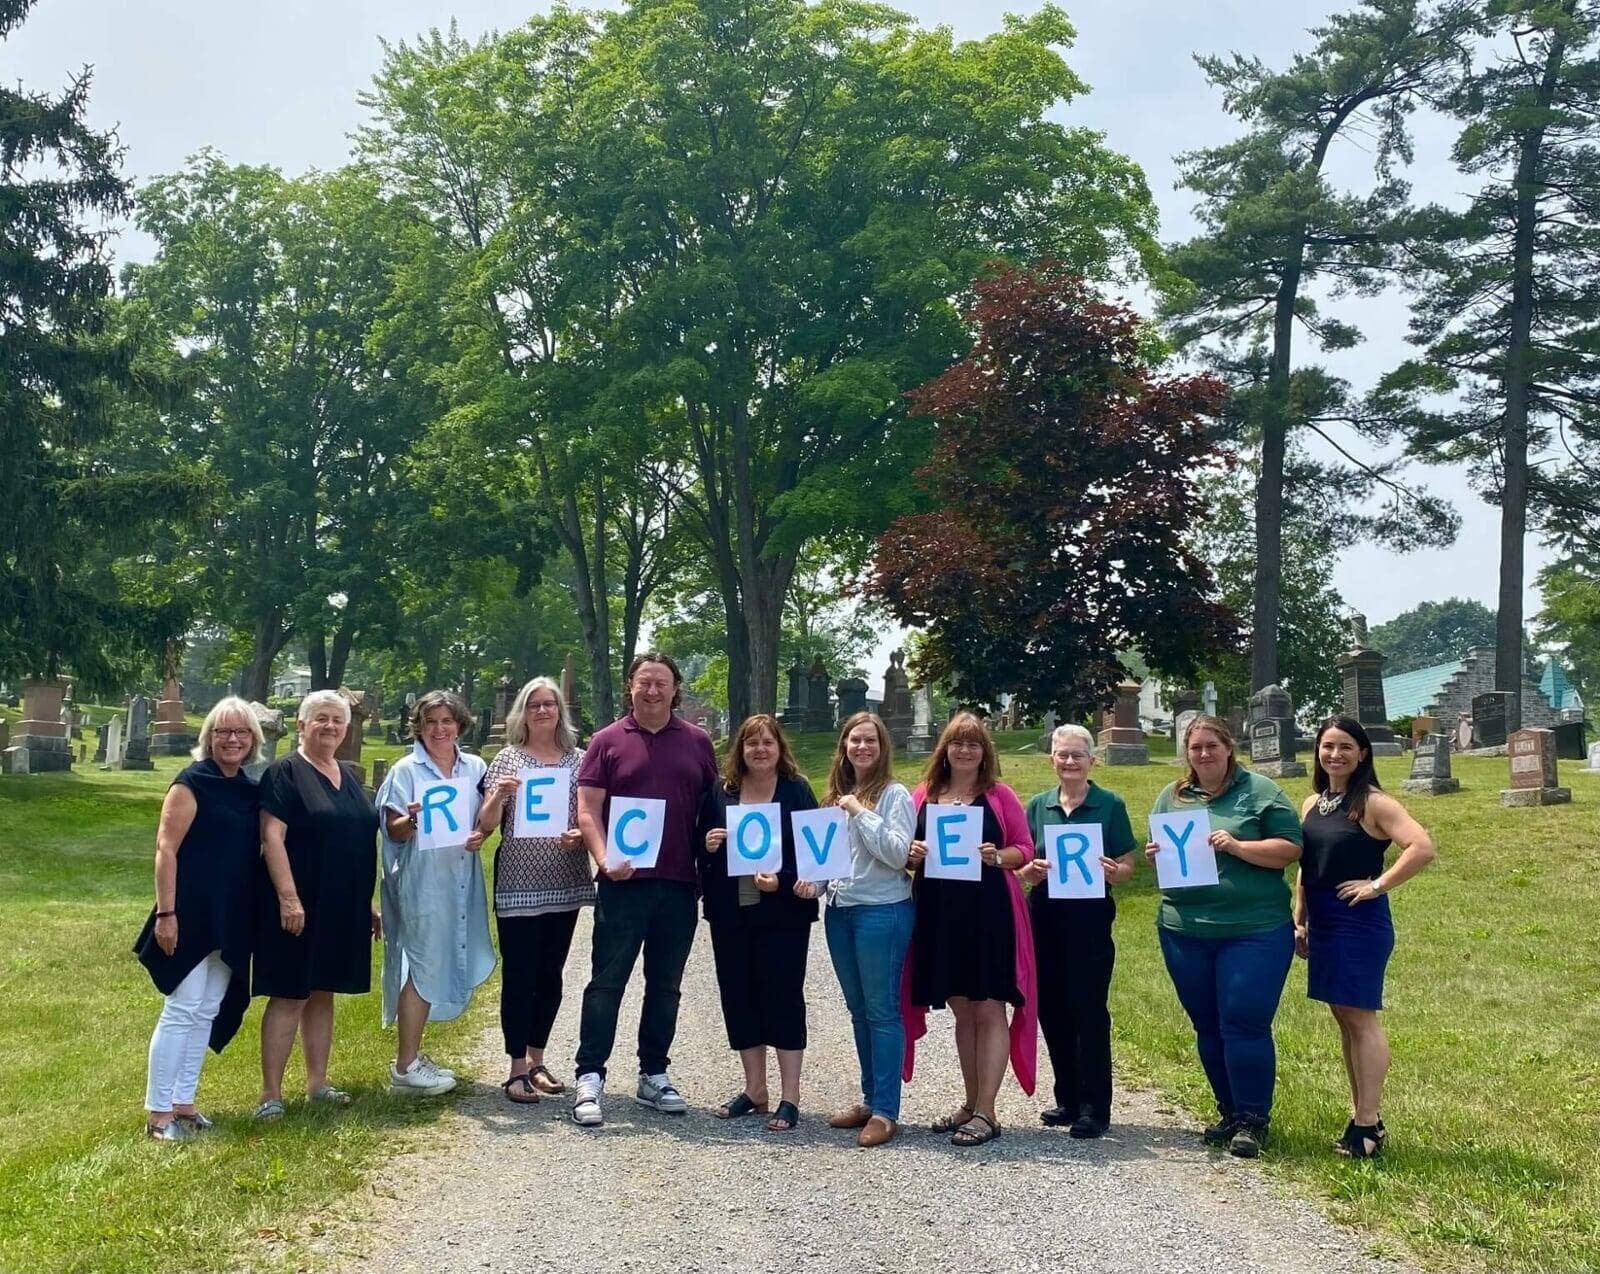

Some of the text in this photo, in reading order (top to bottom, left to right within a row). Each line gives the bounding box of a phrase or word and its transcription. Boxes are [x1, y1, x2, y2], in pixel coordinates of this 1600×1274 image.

[422, 785, 458, 834] R
[526, 777, 555, 821] E
[614, 809, 649, 857] C
[736, 811, 772, 860] O
[801, 822, 837, 865] V
[936, 814, 970, 866] E
[1163, 820, 1195, 877] Y
[1056, 832, 1093, 886] R
